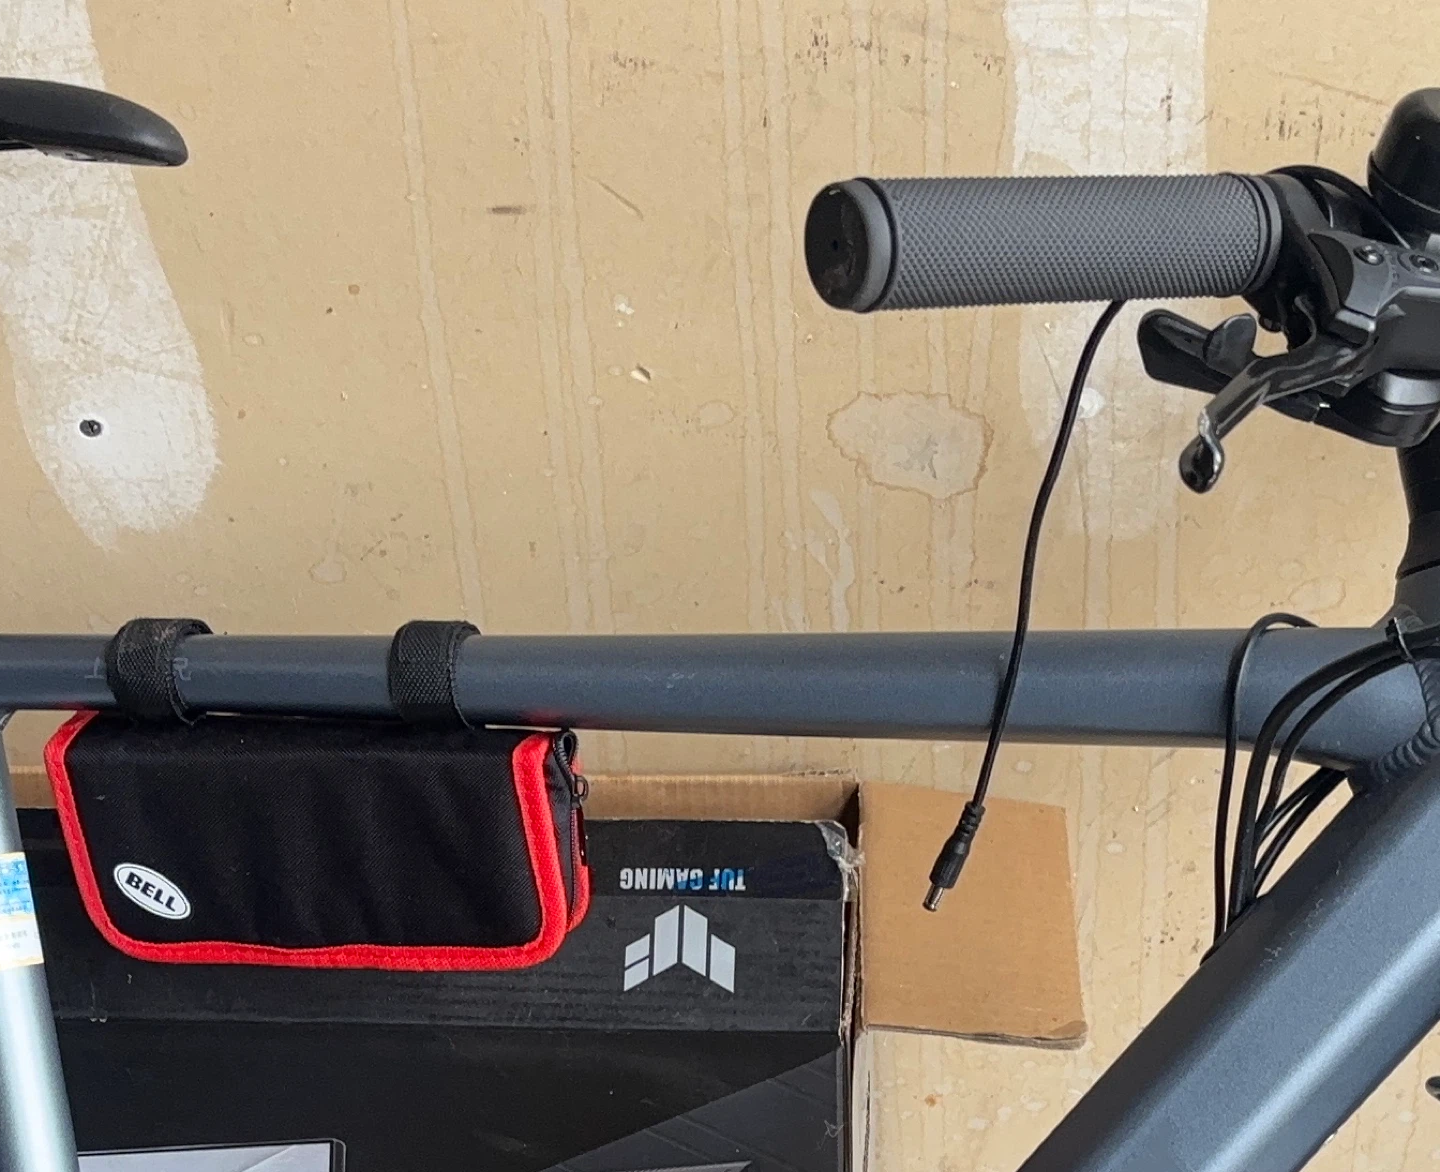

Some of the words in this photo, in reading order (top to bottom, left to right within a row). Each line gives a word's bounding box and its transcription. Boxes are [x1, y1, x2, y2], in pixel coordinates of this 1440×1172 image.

[620, 867, 703, 890] GAMING
[709, 868, 746, 891] TUF
[125, 872, 176, 912] BELL
